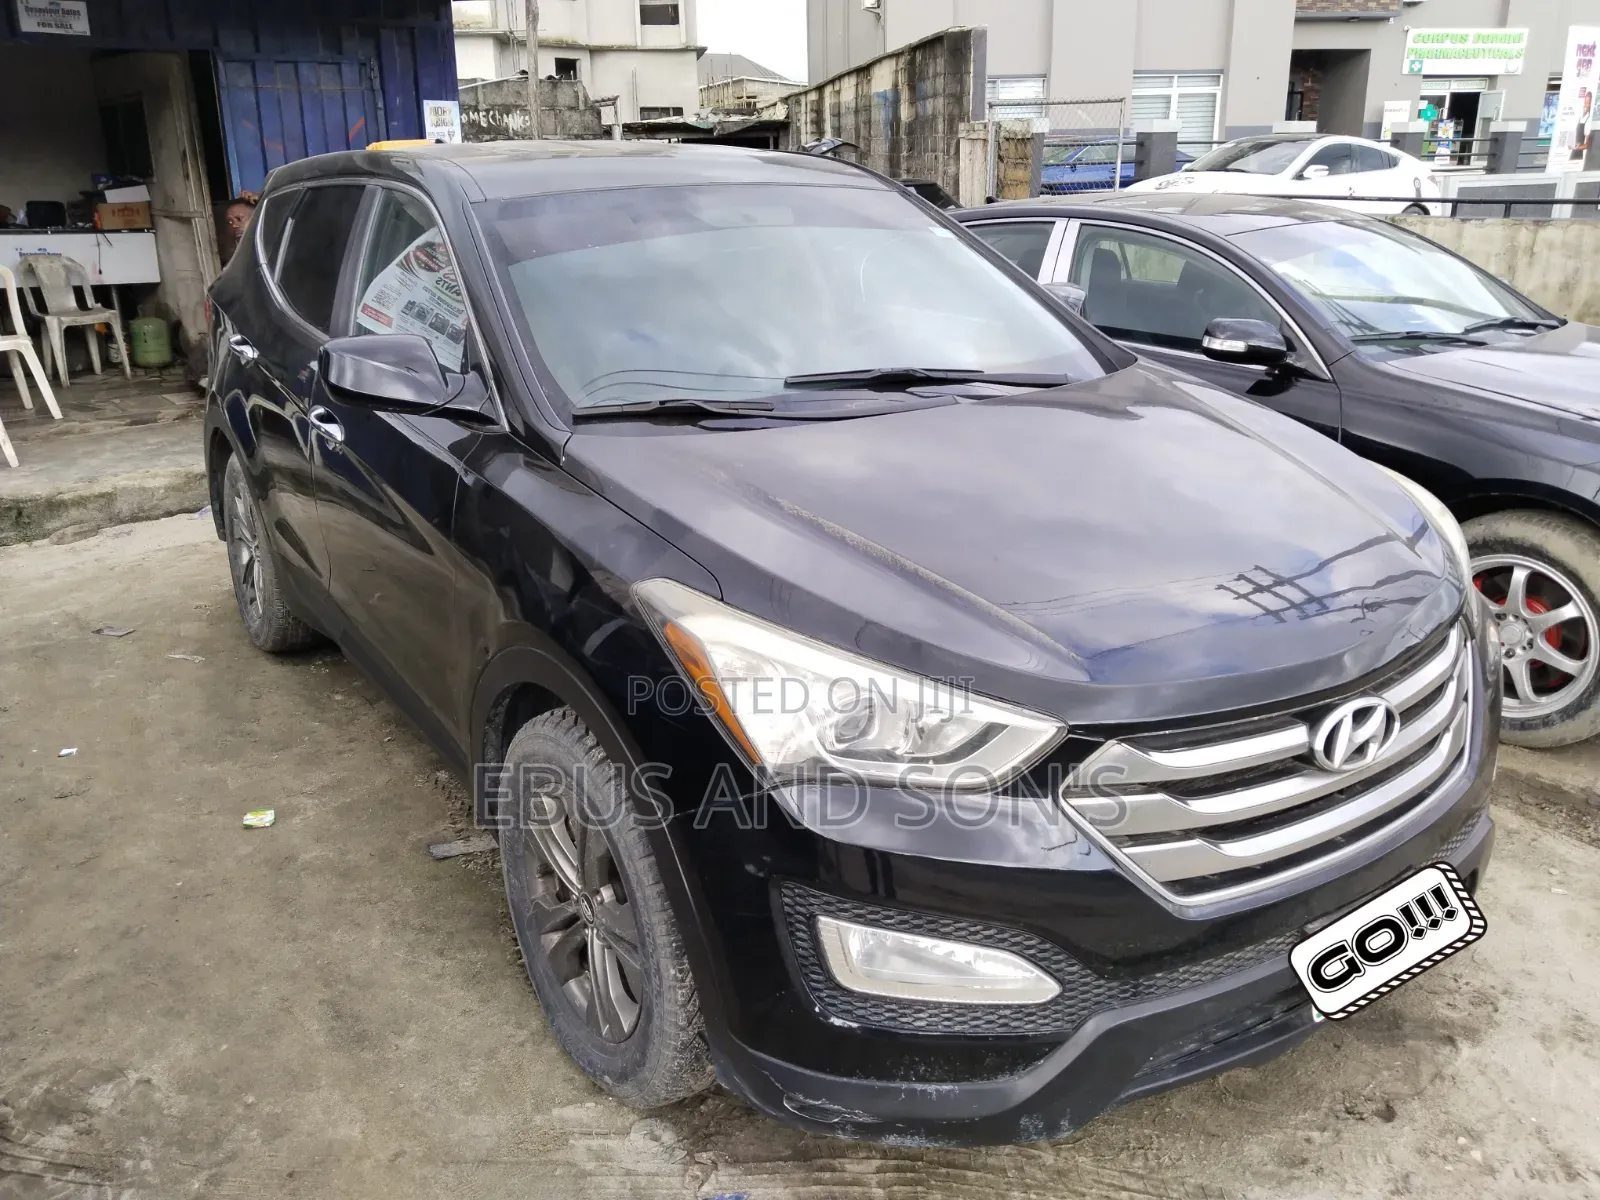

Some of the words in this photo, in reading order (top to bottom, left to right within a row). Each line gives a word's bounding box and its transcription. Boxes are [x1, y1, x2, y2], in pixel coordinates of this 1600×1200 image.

[55, 22, 73, 30] SALE
[1413, 33, 1469, 44] CORPUS
[1406, 47, 1524, 60] PHARMACEUTICALS
[1576, 41, 1596, 57] next
